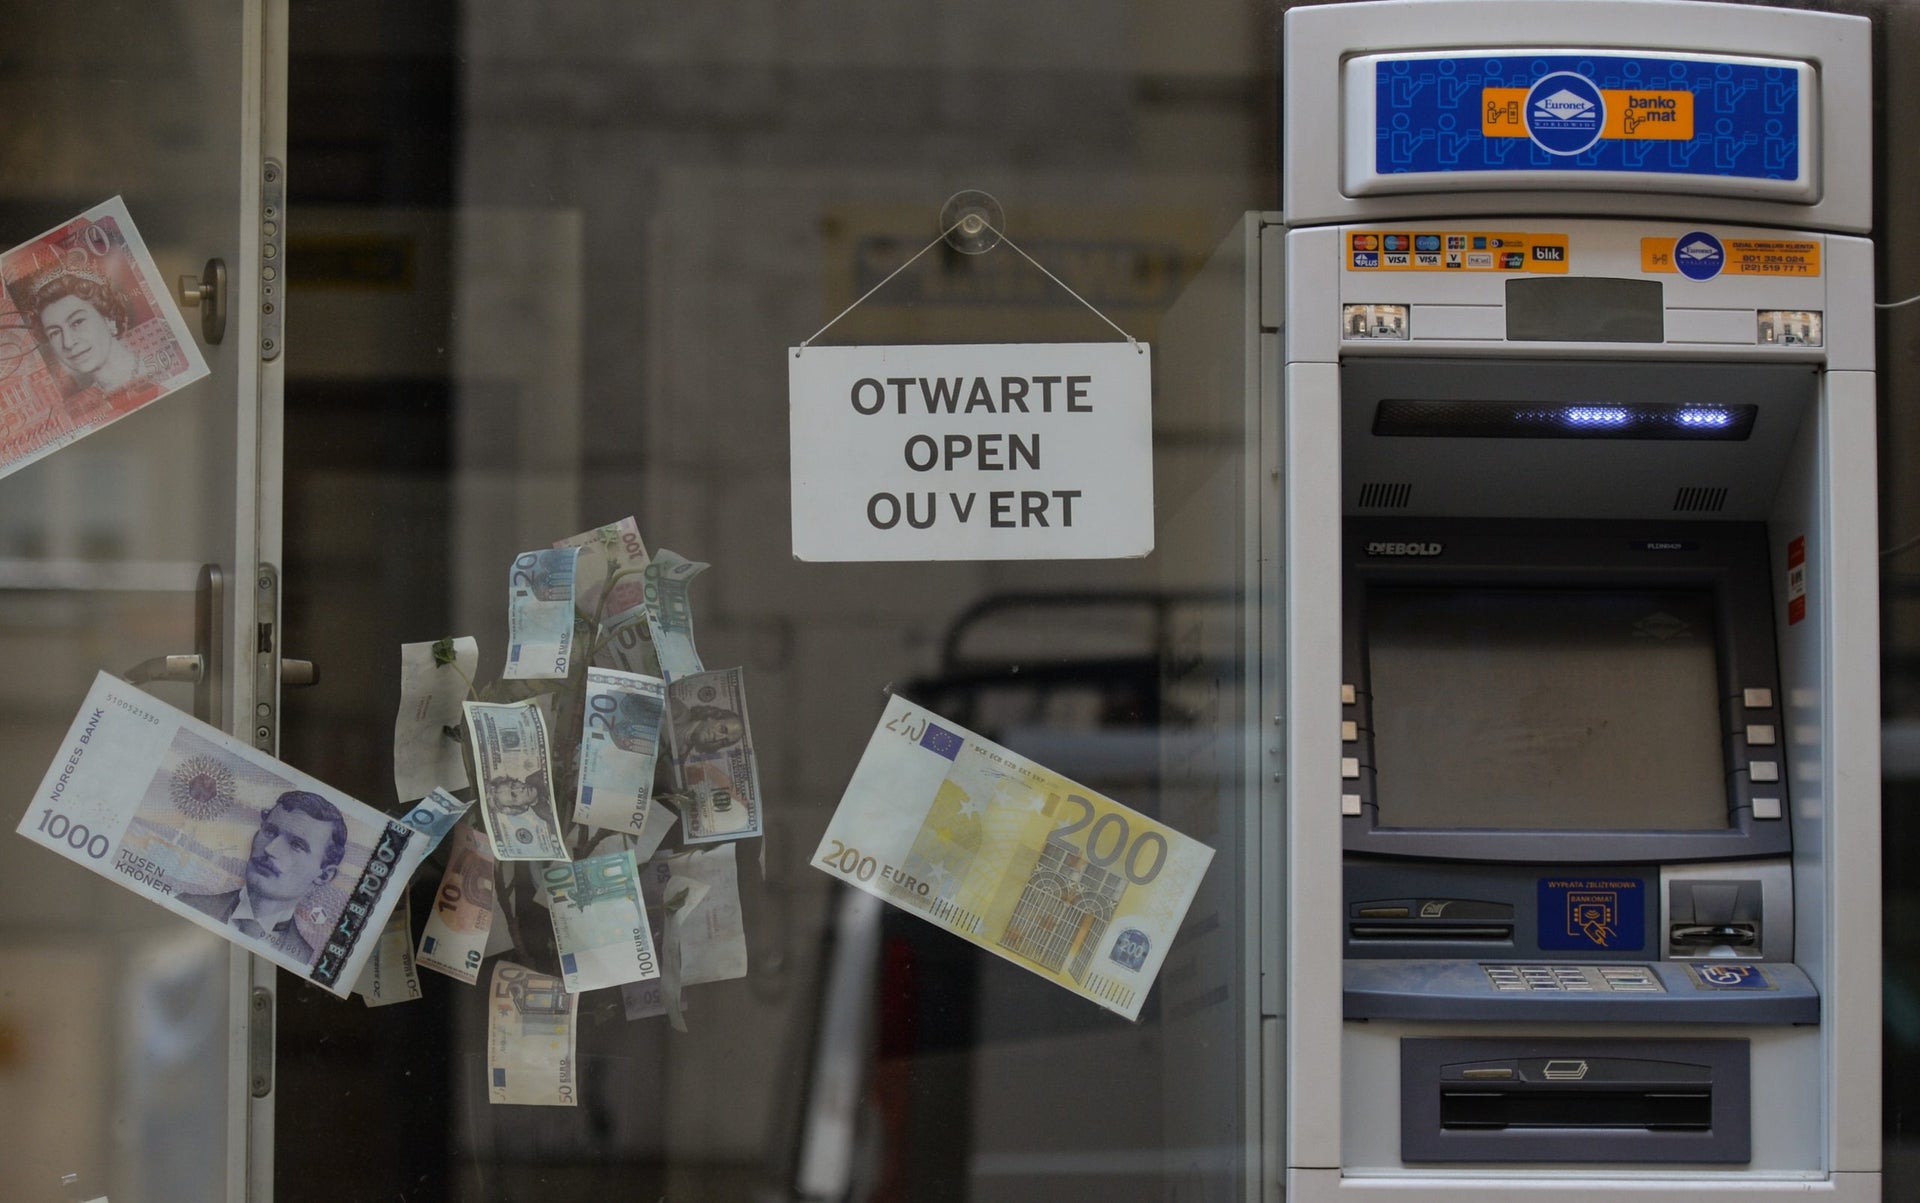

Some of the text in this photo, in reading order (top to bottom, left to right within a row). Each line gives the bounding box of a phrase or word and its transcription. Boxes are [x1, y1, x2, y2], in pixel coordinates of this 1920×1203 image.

[1545, 99, 1585, 110] Euronet
[1629, 95, 1676, 109] banko
[1647, 110, 1676, 122] mat
[1388, 256, 1408, 264] VISA
[1419, 256, 1438, 264] VISA
[1536, 247, 1560, 260] blik
[1741, 264, 1760, 272] (22)
[850, 375, 1093, 415] OTWARTE
[904, 434, 1040, 472] OPEN
[867, 490, 1082, 530] OUVERT
[1368, 542, 1442, 555] DIEBOLD
[513, 554, 538, 589] 20
[554, 657, 567, 674] 20
[589, 694, 618, 732] 20
[50, 707, 105, 802] NORGES BANK
[630, 786, 645, 830] 20 EURO
[37, 808, 110, 860] 1000
[1048, 794, 1168, 886] 200
[114, 860, 173, 896] KRONER
[121, 849, 166, 878] TUSEN
[822, 840, 930, 896] 200 EURO
[438, 884, 461, 913] 10
[465, 949, 482, 971] 10
[632, 927, 655, 978] 100 EURO
[558, 1084, 573, 1104] 50
